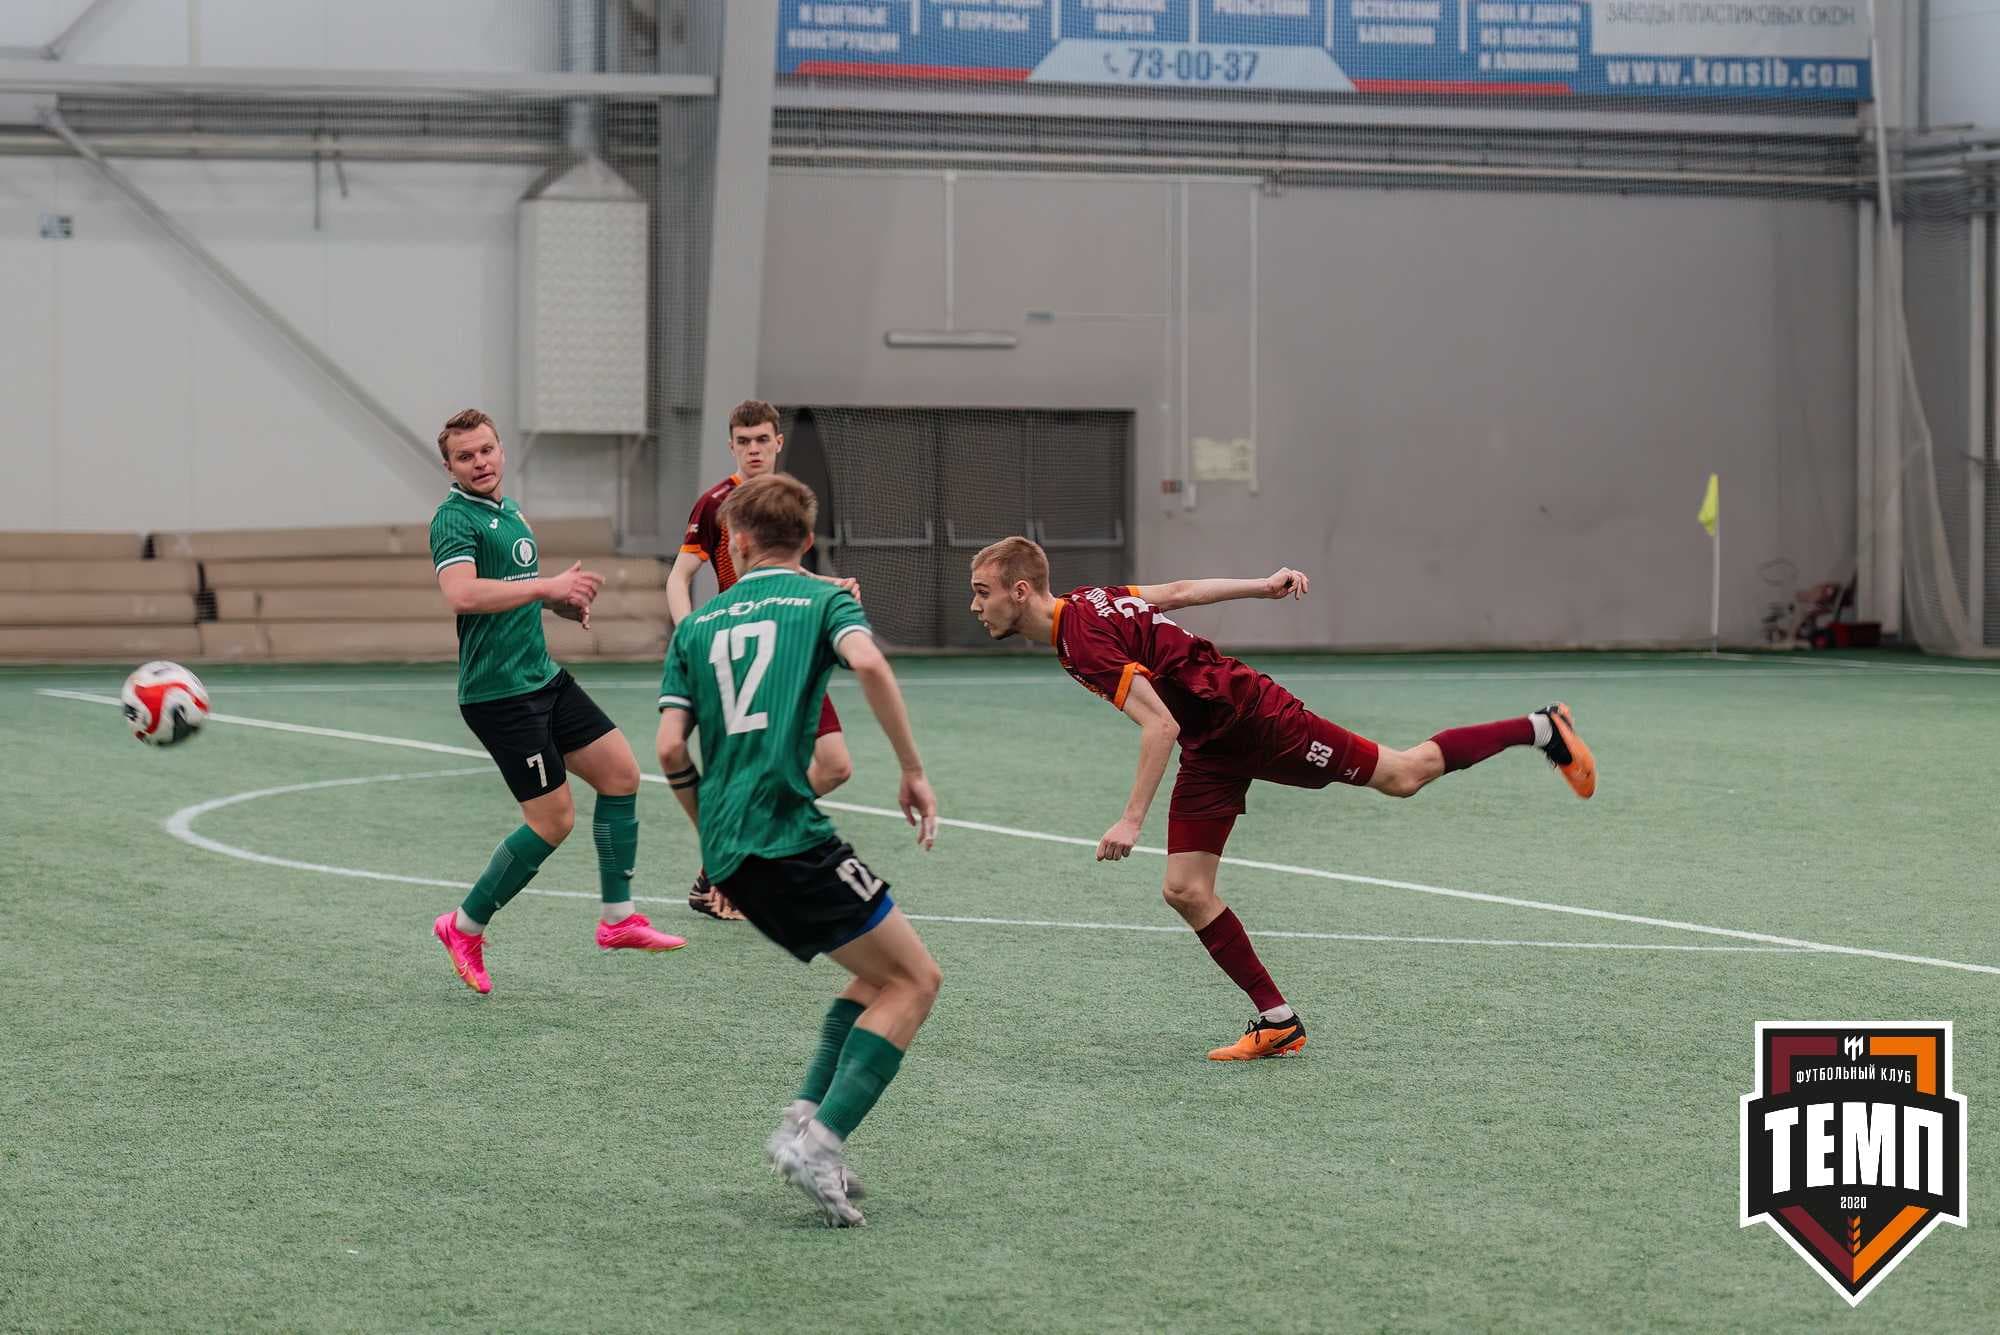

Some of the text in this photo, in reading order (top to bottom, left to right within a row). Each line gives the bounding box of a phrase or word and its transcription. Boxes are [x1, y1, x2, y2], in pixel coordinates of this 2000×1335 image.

[1680, 4, 1807, 26] ПЛАСТИКОВЫХ
[1809, 6, 1856, 27] ОКОН
[1128, 47, 1259, 82] 73-00-37
[1605, 58, 1859, 88] www.konsib.com
[708, 619, 777, 737] 12
[526, 752, 548, 788] 7
[1305, 740, 1334, 768] 33
[835, 858, 883, 902] 12
